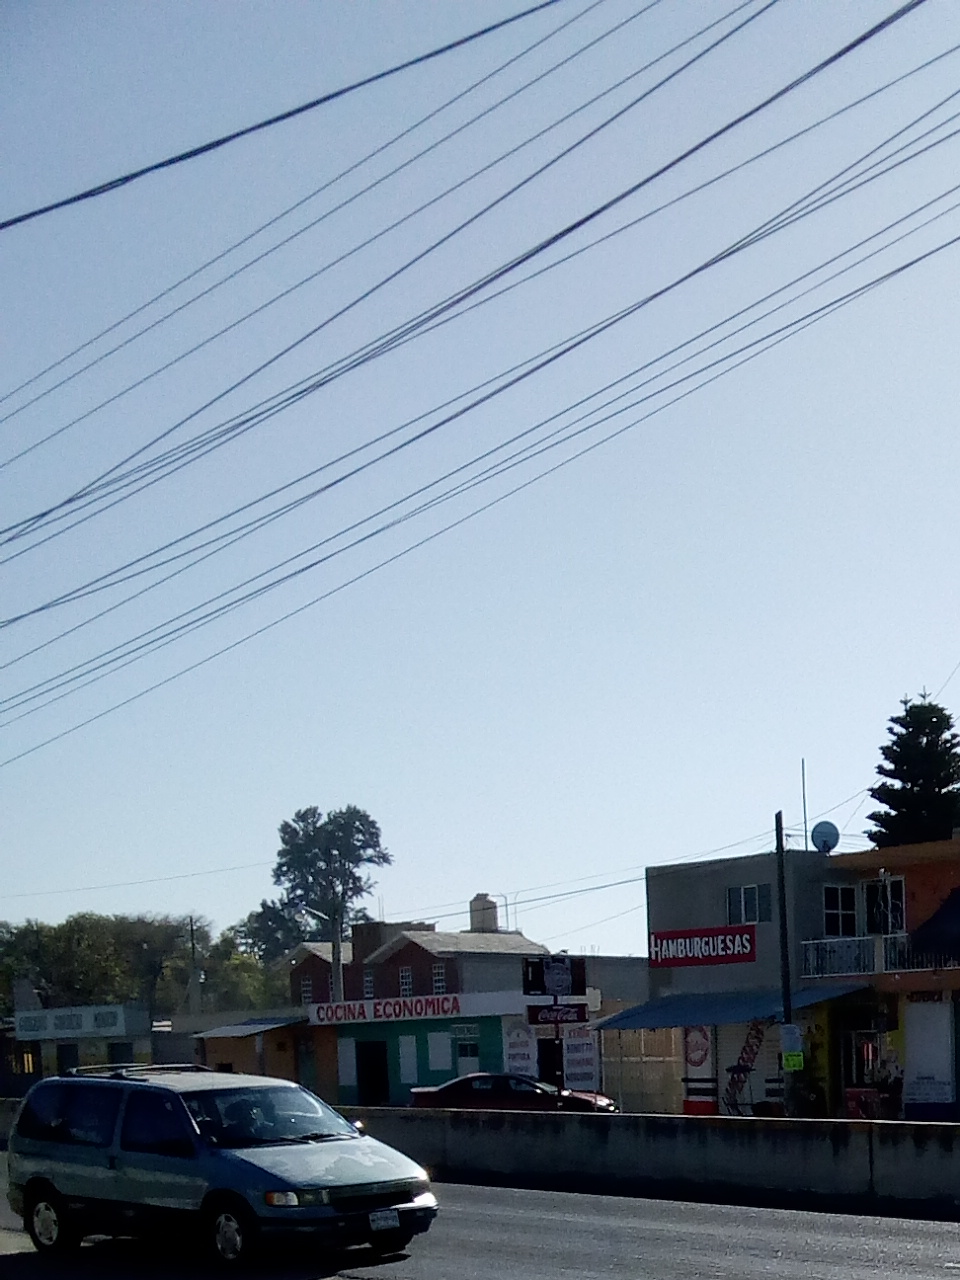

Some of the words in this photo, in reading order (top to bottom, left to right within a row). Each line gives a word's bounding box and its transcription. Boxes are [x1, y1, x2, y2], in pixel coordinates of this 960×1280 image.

[650, 933, 752, 963] HAMBURGUESAS
[316, 1003, 367, 1022] COCINA
[373, 996, 461, 1019] ECONOMICA
